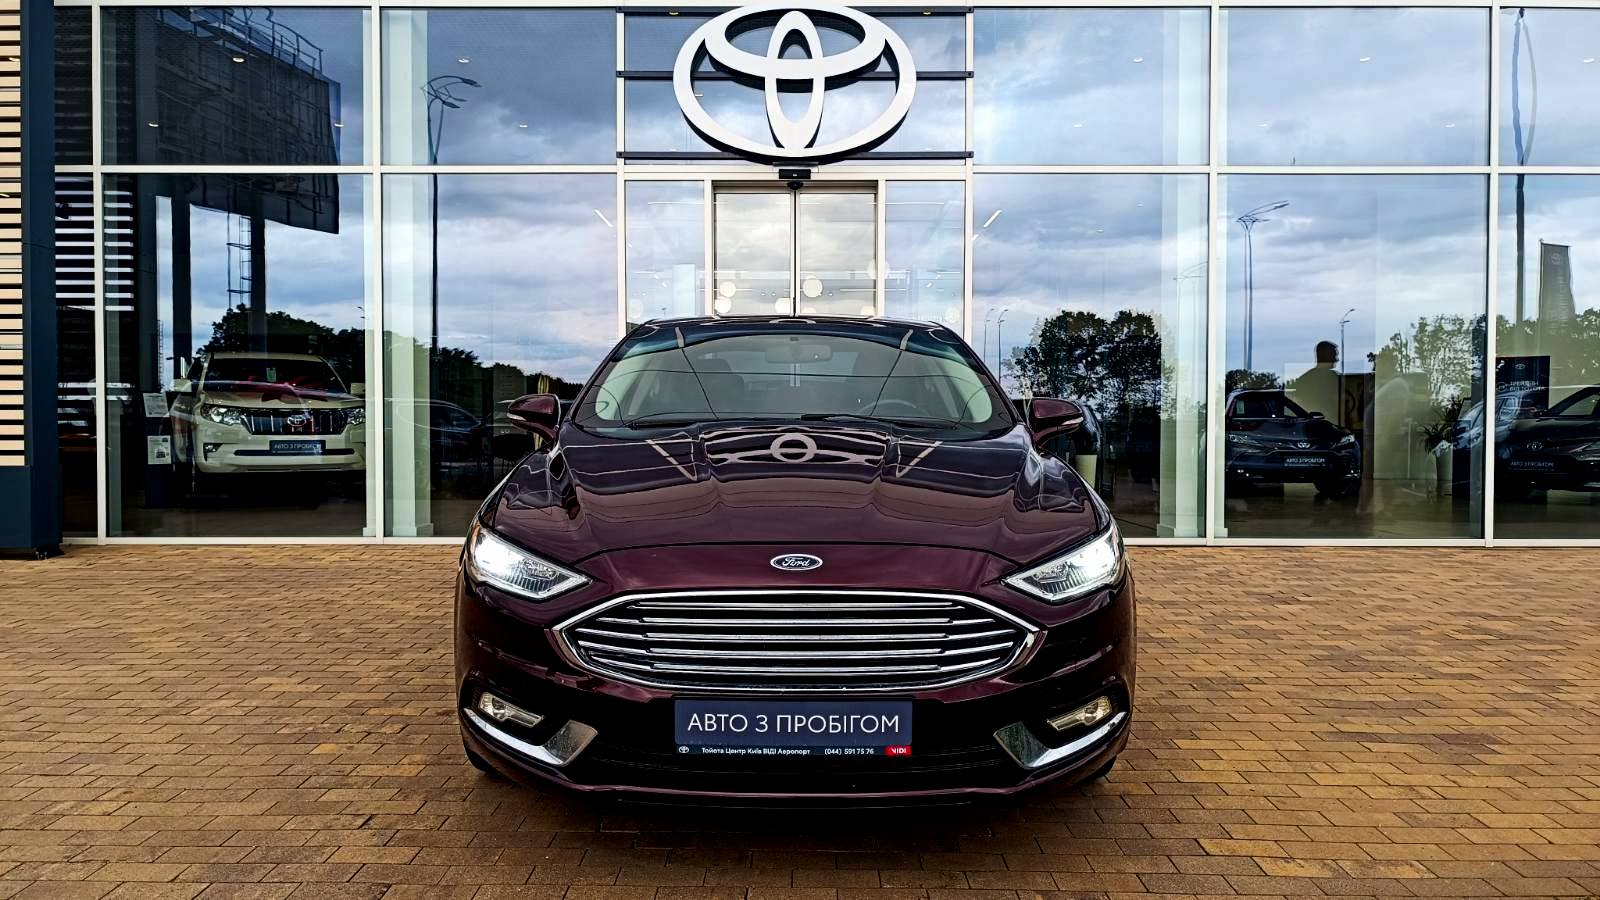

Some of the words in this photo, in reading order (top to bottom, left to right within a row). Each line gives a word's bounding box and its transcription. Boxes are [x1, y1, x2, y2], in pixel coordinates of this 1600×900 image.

[782, 556, 811, 567] Ford
[687, 712, 748, 732] АВТО
[755, 714, 769, 733] З
[776, 714, 900, 734] ПРОБІГОМ
[725, 747, 746, 756] Центр
[777, 747, 811, 756] Аеропорт
[824, 747, 842, 756] (044)
